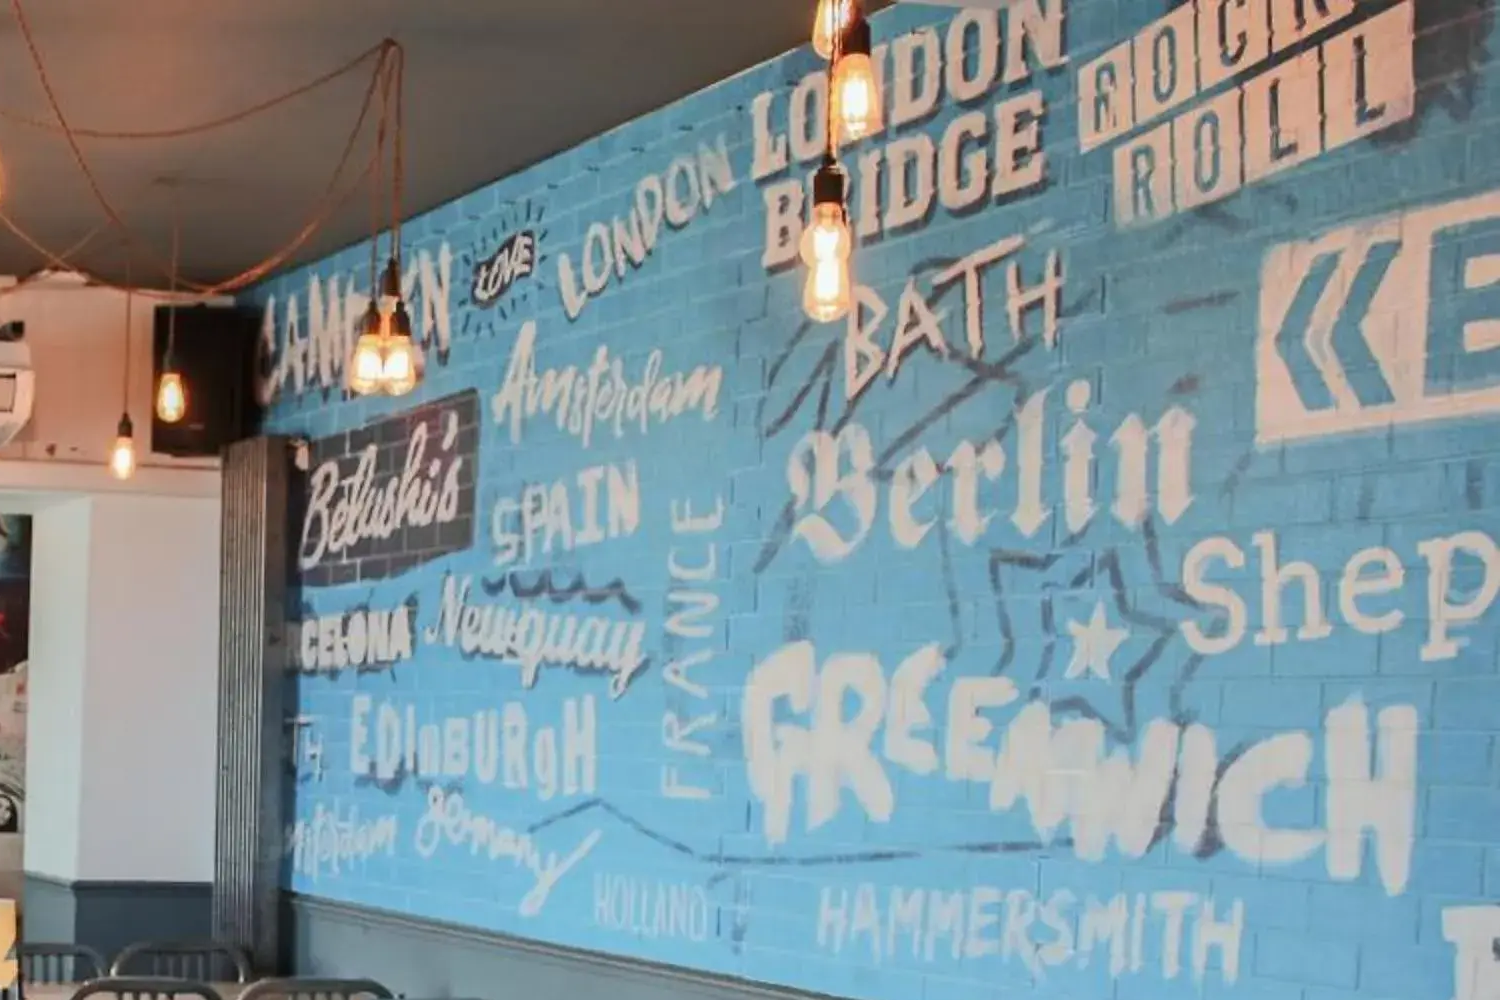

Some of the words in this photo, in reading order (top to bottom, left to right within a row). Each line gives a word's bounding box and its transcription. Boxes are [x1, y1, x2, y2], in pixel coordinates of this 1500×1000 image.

[1130, 33, 1386, 220] ROLL
[474, 235, 533, 299] LOVE
[557, 131, 737, 321] LONDON
[492, 321, 723, 446] Amsterdam
[845, 233, 1068, 399] BATH
[299, 410, 463, 570] Belushi's
[492, 459, 639, 566] SPAIN
[787, 380, 1197, 564] Berlin
[426, 575, 648, 701] Newquay
[661, 494, 724, 800] FRANCE
[1181, 530, 1500, 661] Shep
[742, 640, 1417, 896] GREENWICH
[594, 871, 707, 941] HOLLAND
[817, 885, 1244, 986] HAMMERSMITH
